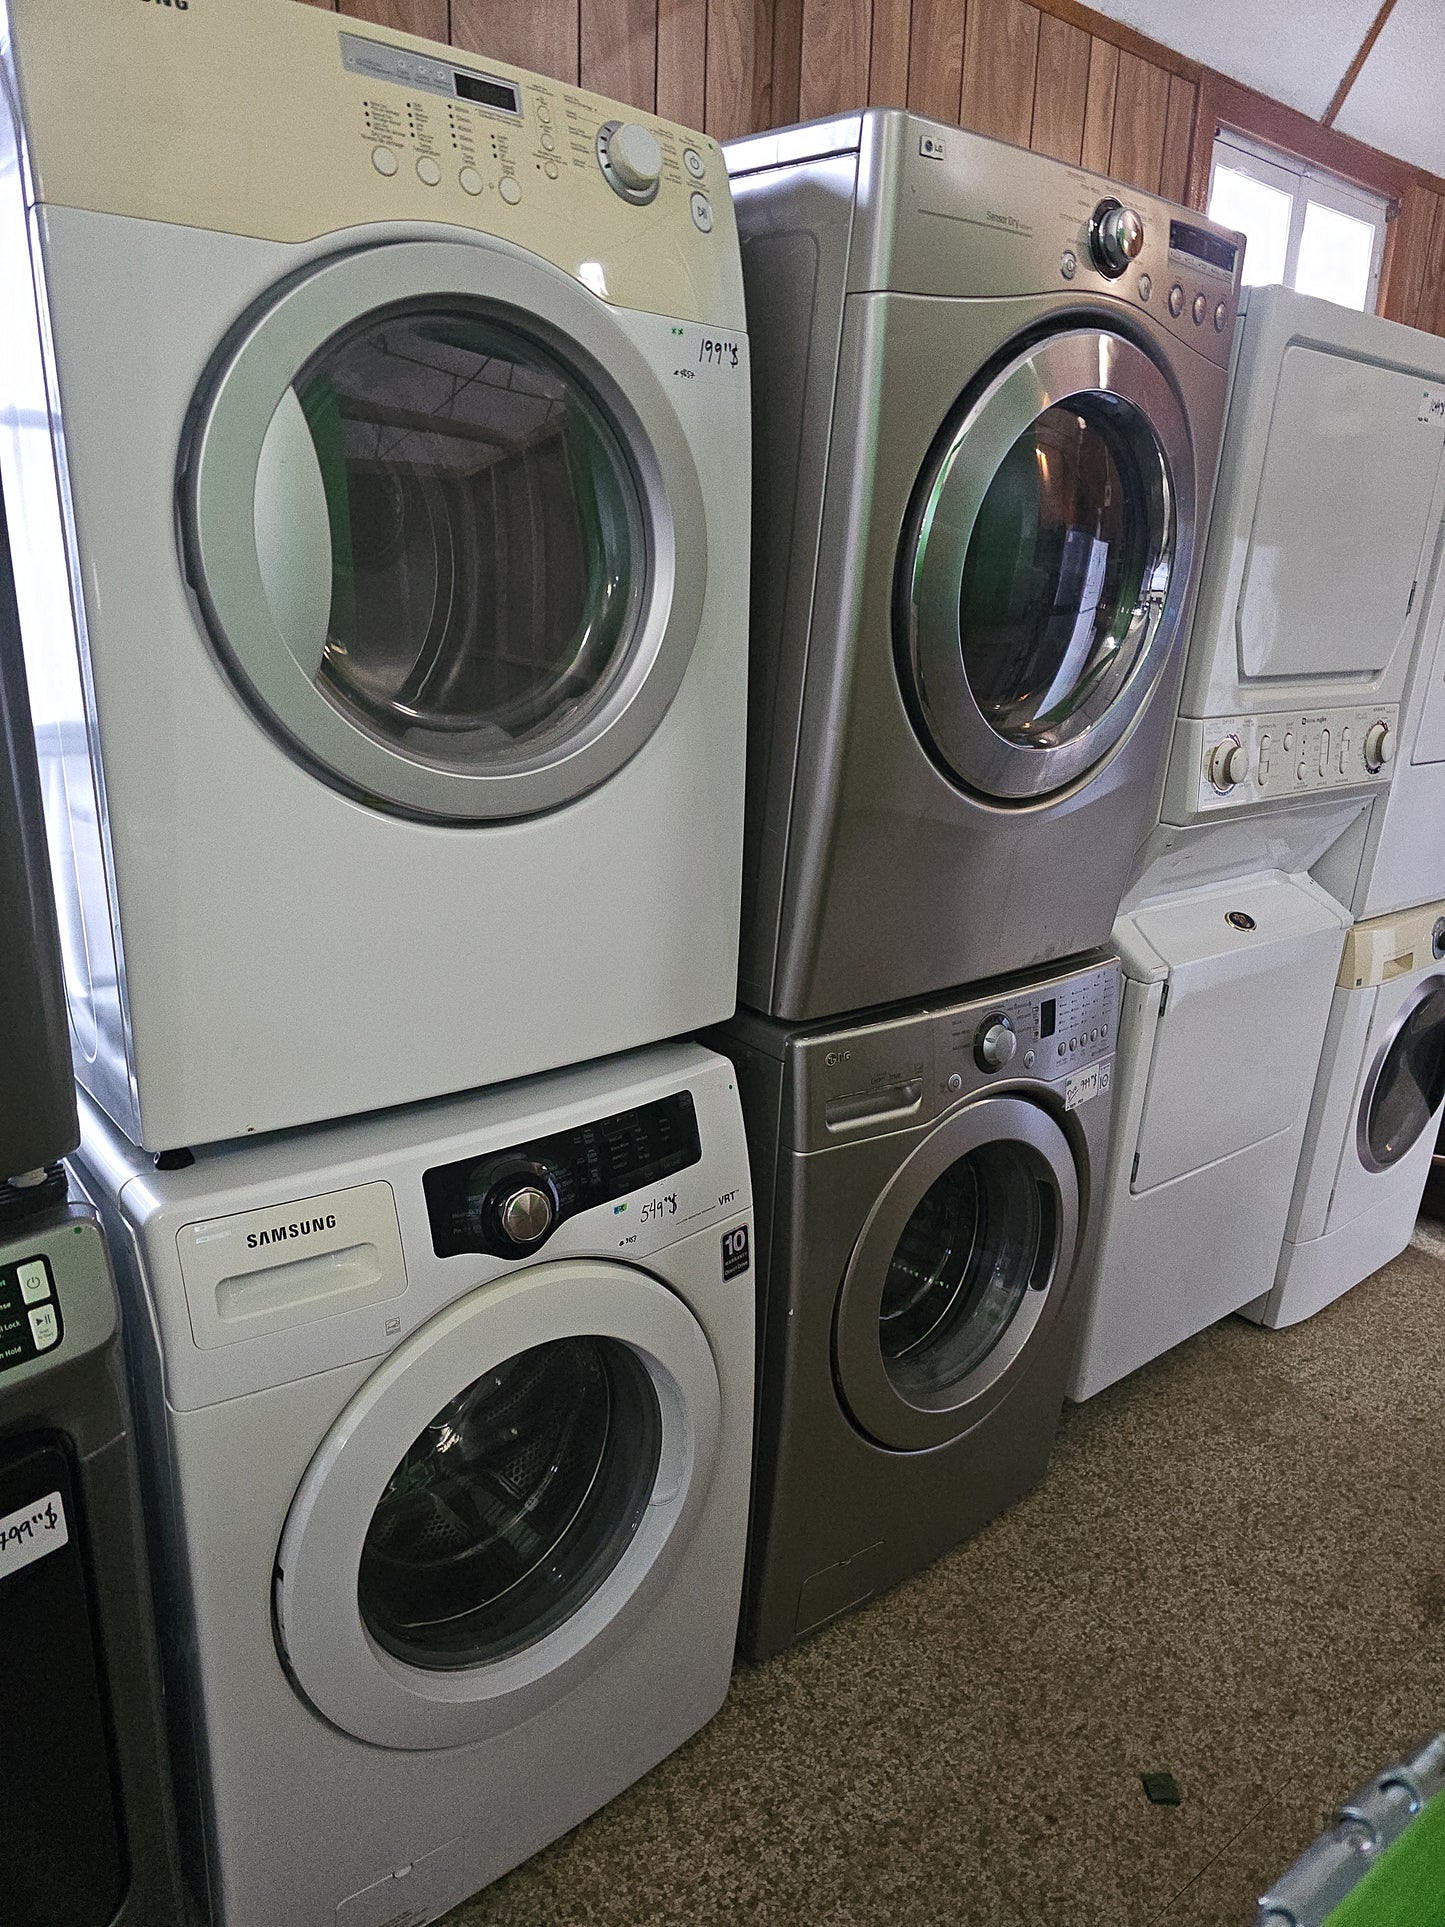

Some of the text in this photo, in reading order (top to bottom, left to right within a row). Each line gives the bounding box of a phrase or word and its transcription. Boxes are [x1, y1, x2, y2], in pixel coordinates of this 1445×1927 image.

[246, 1214, 337, 1249] SAMSUNG
[724, 1229, 747, 1256] 10
[5, 1345, 21, 1357] Hold
